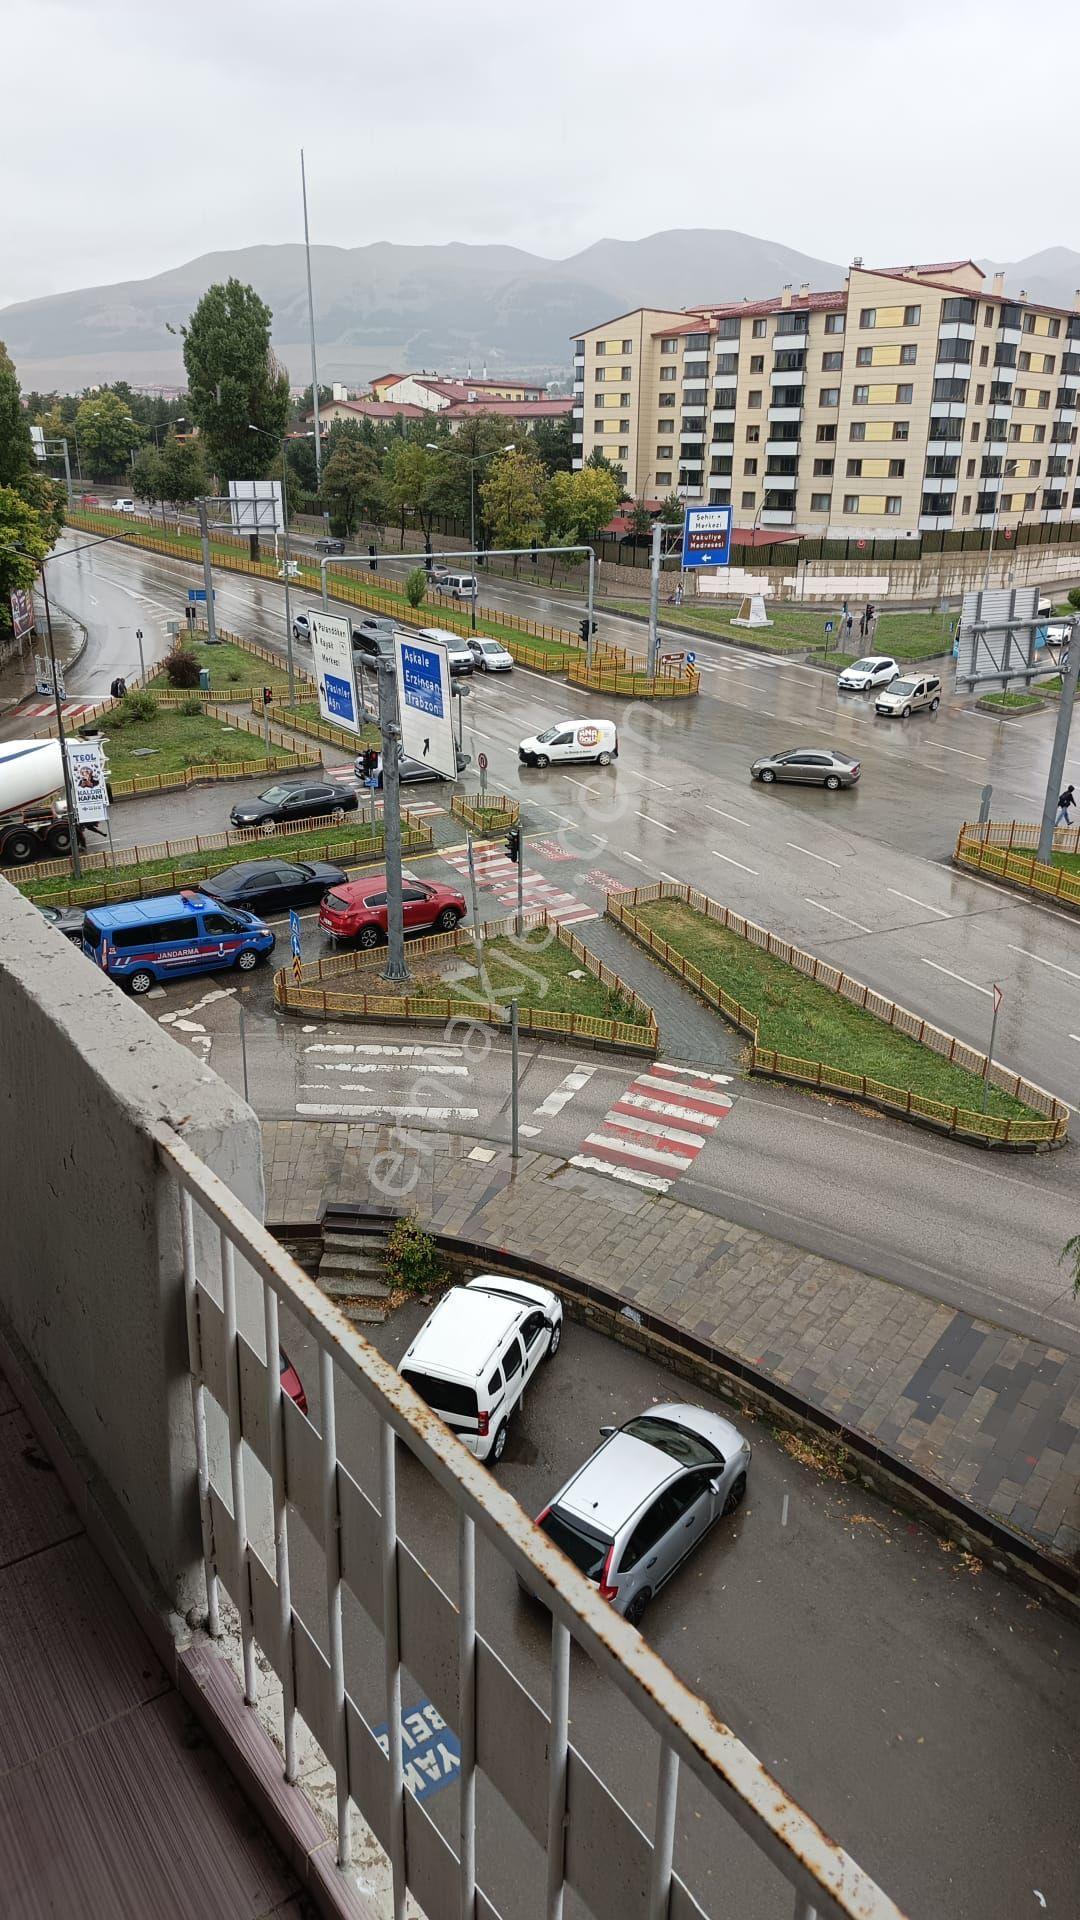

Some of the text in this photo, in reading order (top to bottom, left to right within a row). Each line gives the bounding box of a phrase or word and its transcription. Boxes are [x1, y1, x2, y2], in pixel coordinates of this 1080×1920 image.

[326, 680, 350, 699] Pasinler
[405, 670, 441, 692] Erzincan
[407, 691, 440, 714] Trabzon
[157, 947, 200, 960] JANDARMA
